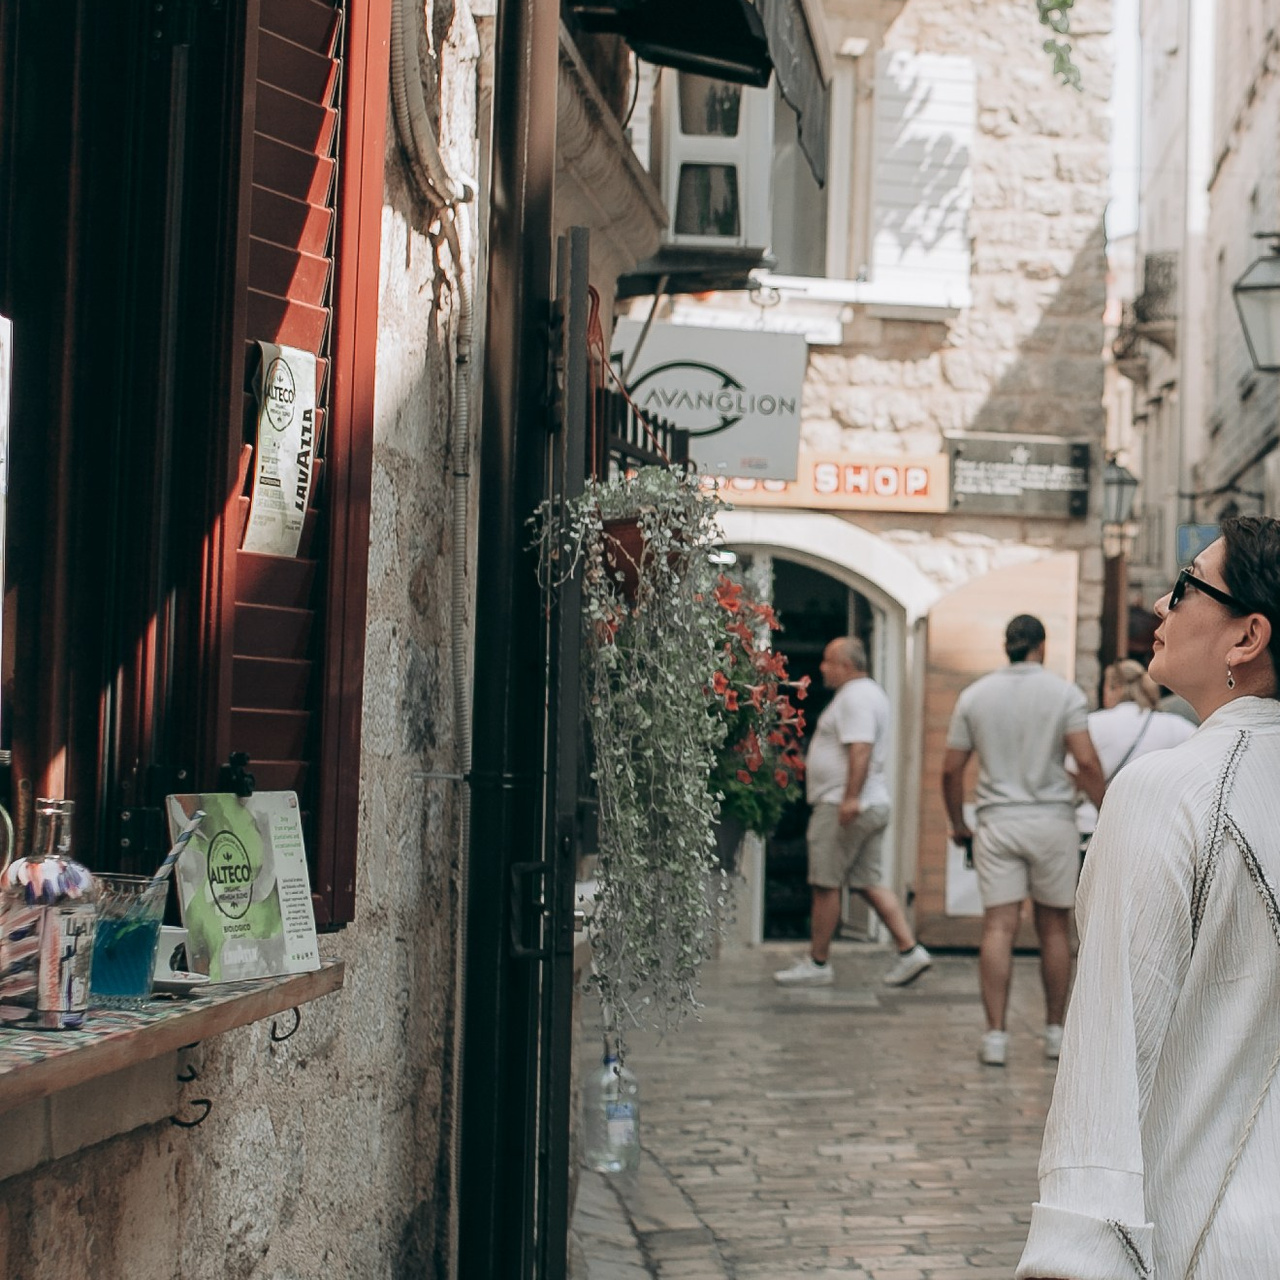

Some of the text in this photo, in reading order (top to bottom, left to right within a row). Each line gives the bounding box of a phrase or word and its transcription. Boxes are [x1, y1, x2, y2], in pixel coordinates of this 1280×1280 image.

[644, 387, 797, 417] AVANGLION
[294, 408, 313, 513] LAVAZZA
[814, 463, 928, 498] SHOP
[211, 865, 251, 885] ALTECO
[223, 923, 252, 934] BIOLOGICO
